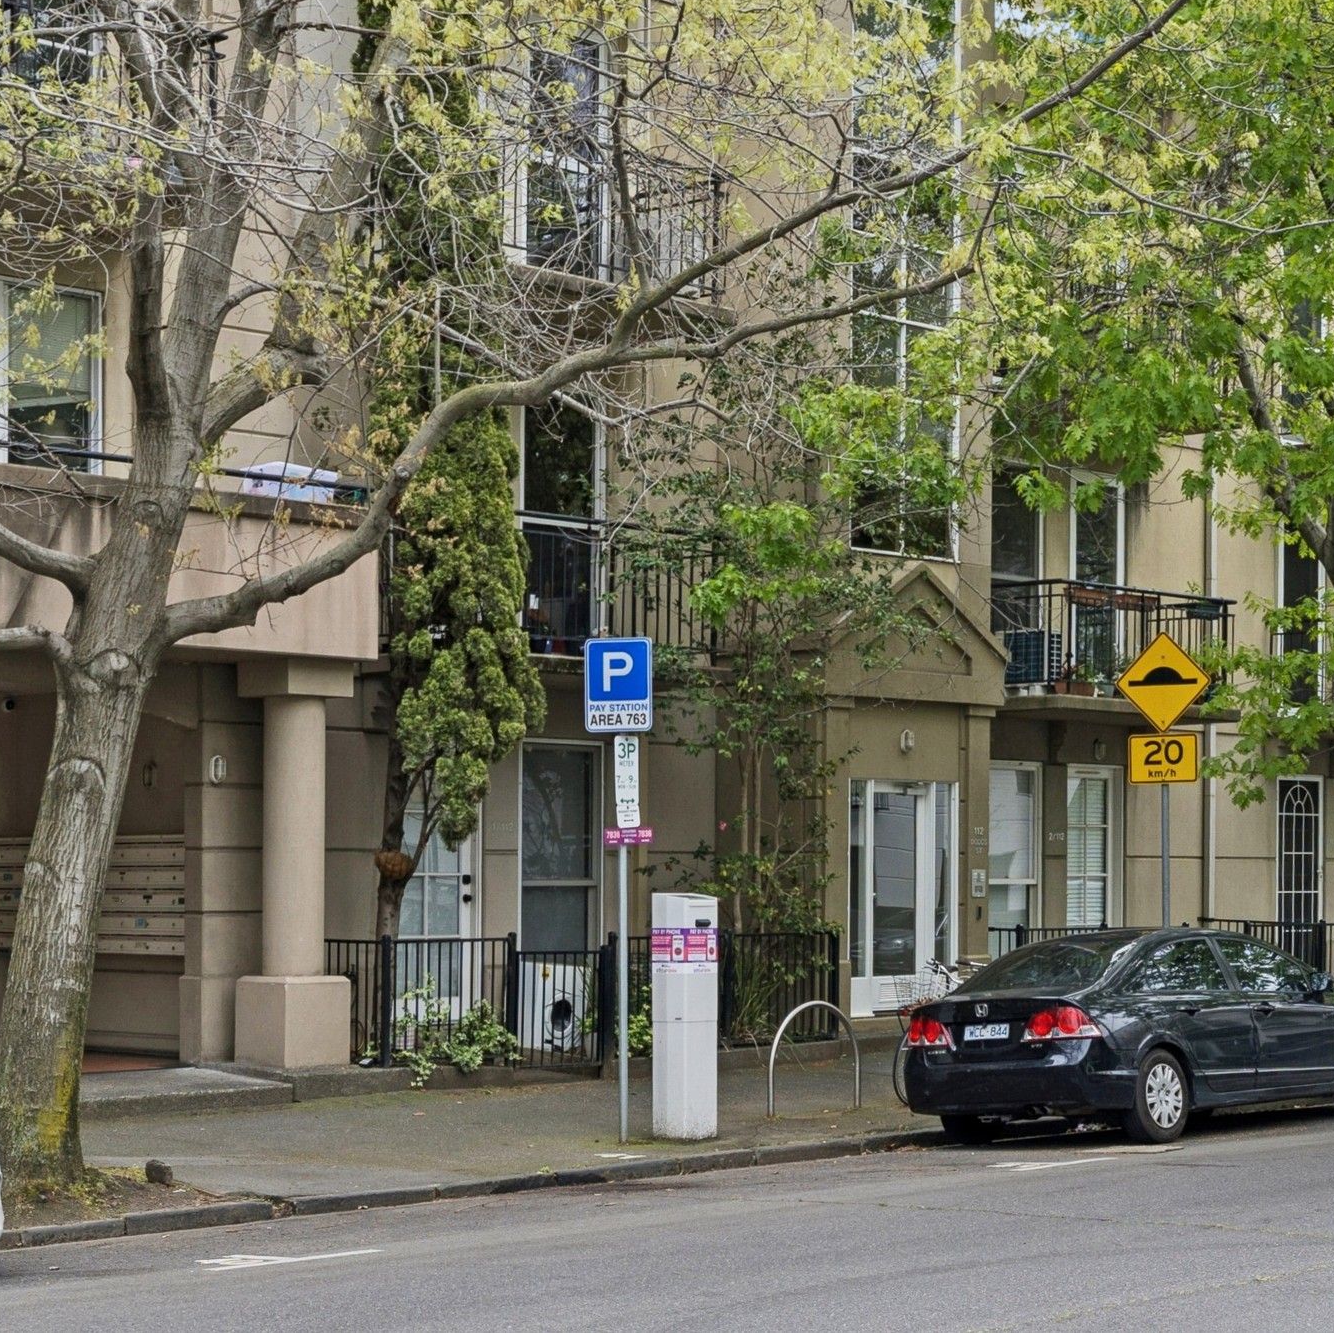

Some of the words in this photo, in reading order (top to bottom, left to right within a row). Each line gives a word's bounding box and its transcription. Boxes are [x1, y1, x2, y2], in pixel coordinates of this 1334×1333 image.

[602, 651, 634, 692] P
[589, 704, 607, 712] PAY
[609, 703, 648, 712] STATION
[590, 714, 623, 726] AREA
[626, 713, 647, 725] 763
[617, 742, 636, 759] 3P
[1143, 739, 1184, 766] 20
[1147, 768, 1177, 779] km/h
